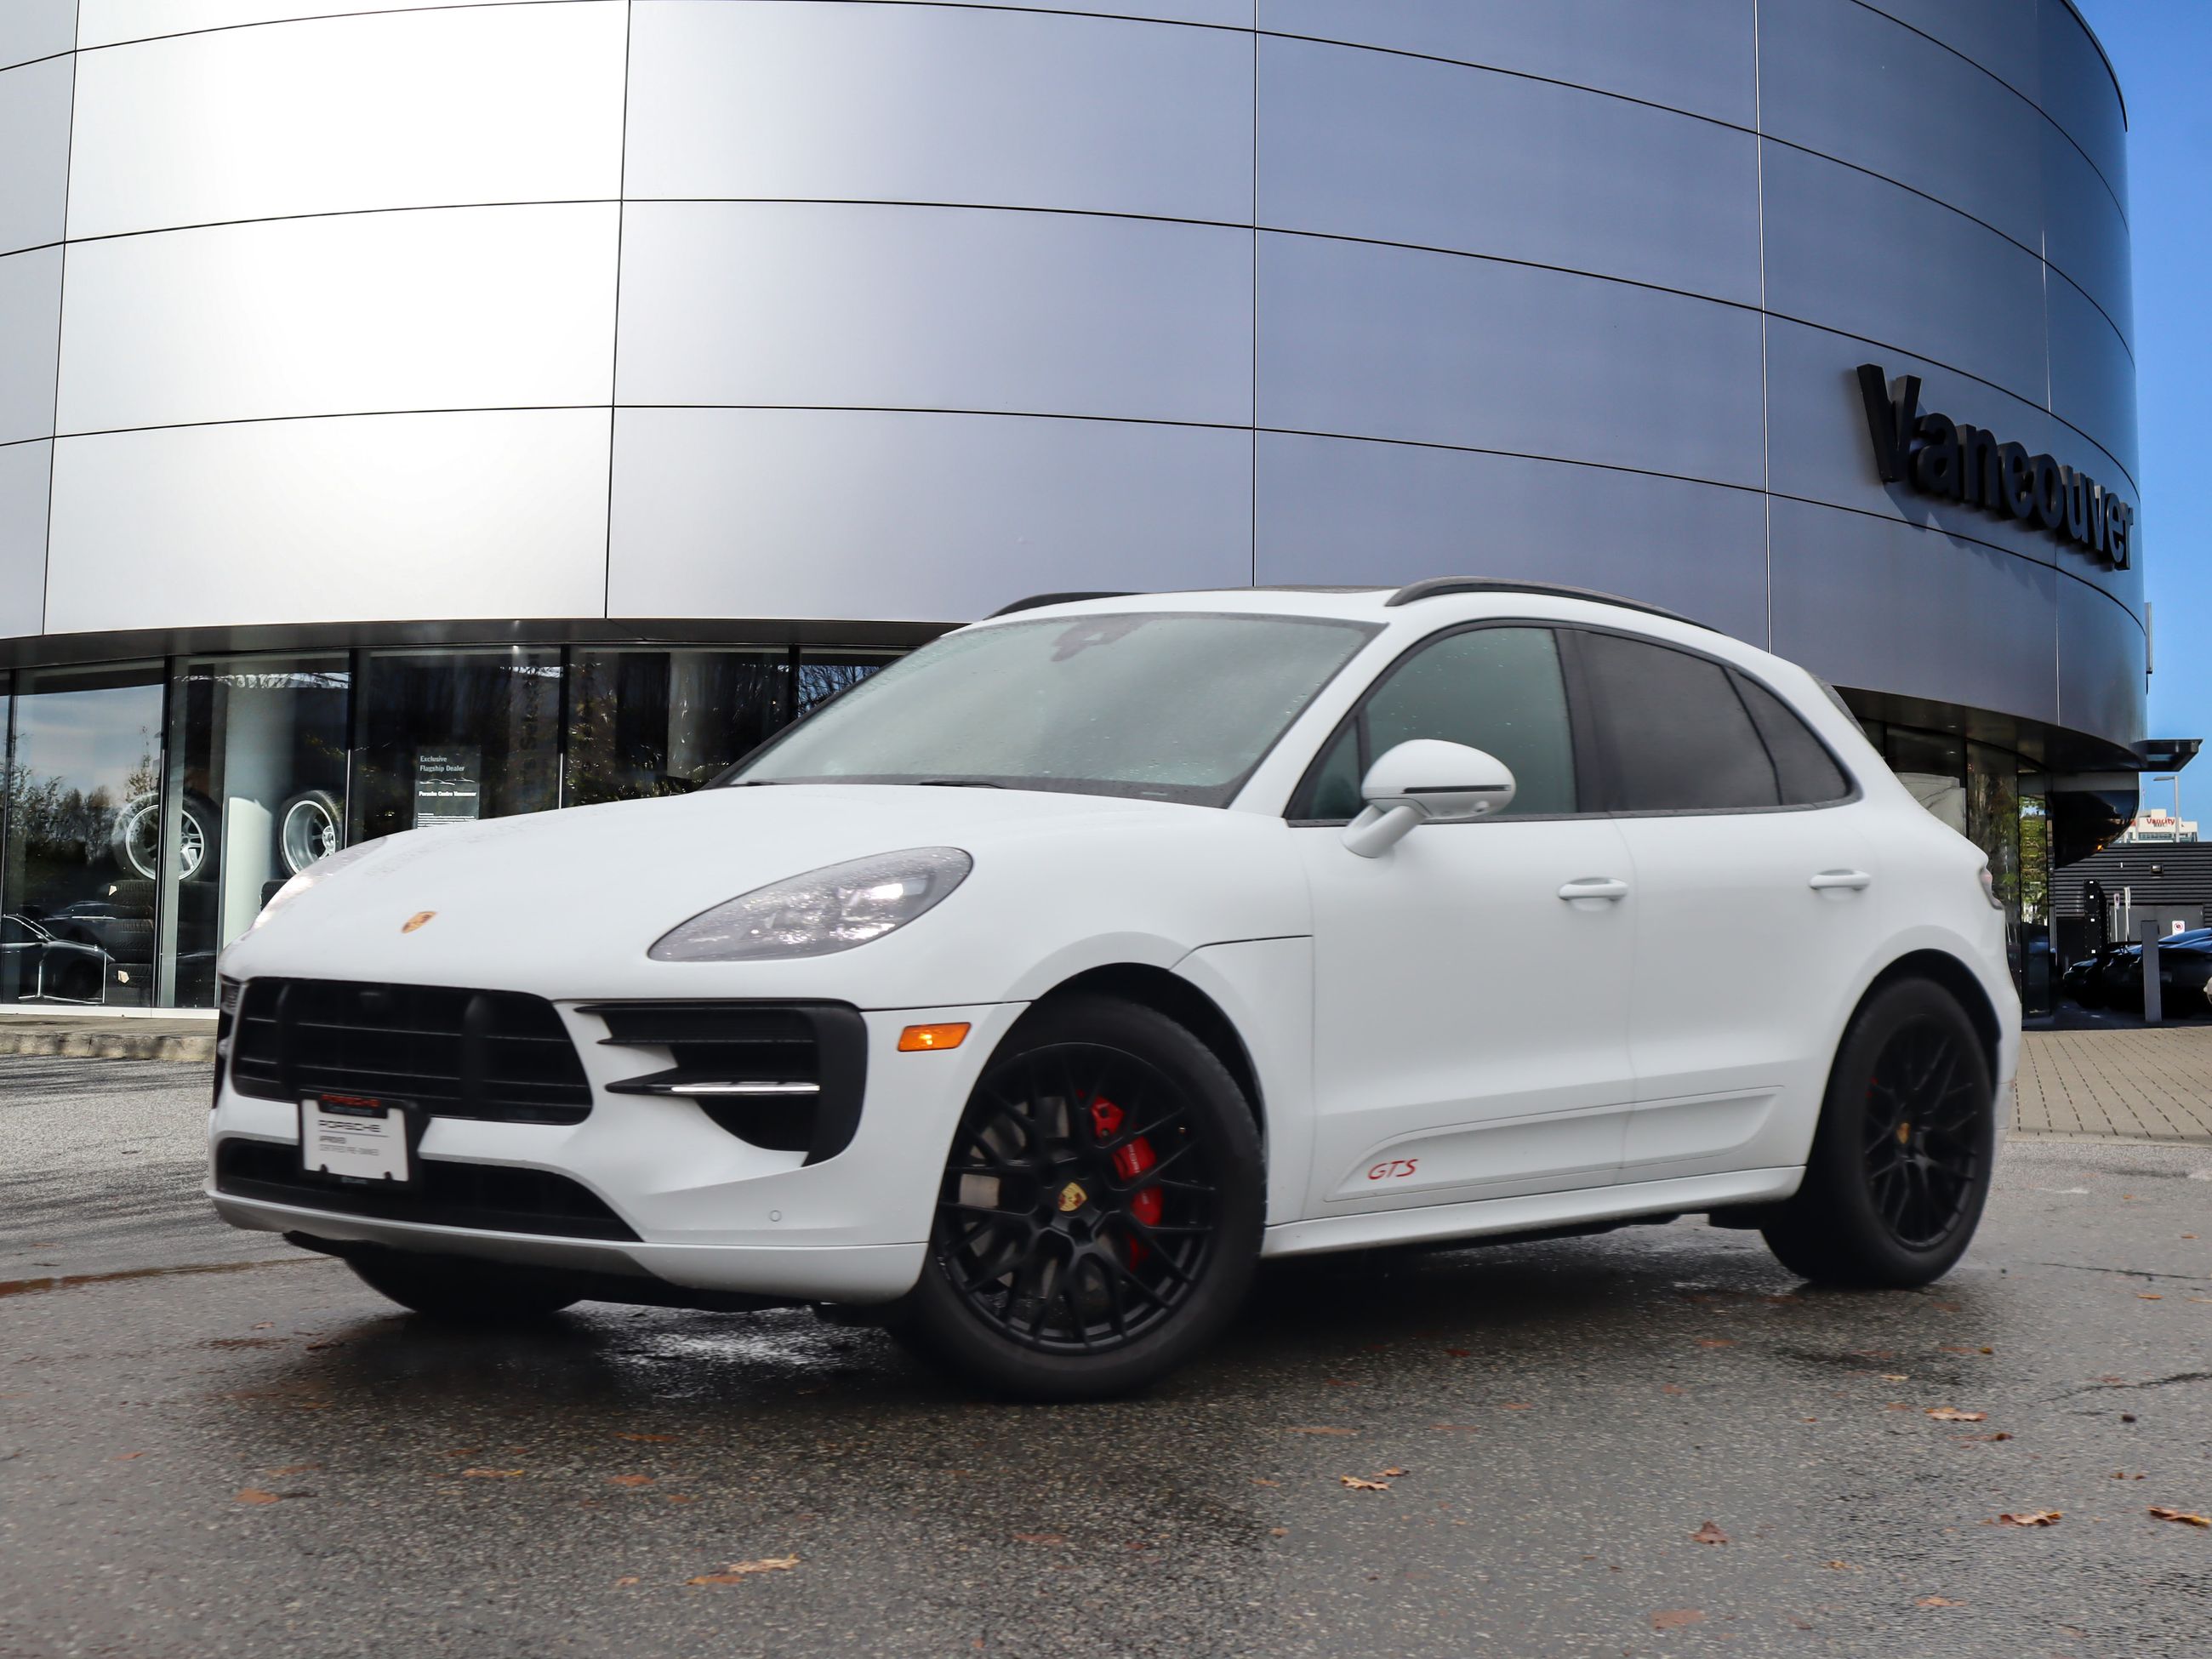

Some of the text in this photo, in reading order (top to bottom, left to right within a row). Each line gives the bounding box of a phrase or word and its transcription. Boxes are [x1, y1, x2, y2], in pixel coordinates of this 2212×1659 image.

[1856, 363, 2134, 571] Vancouver
[2146, 817, 2175, 826] Vancity
[318, 1119, 381, 1133] PORSCHE
[1367, 1158, 1419, 1181] GTS
